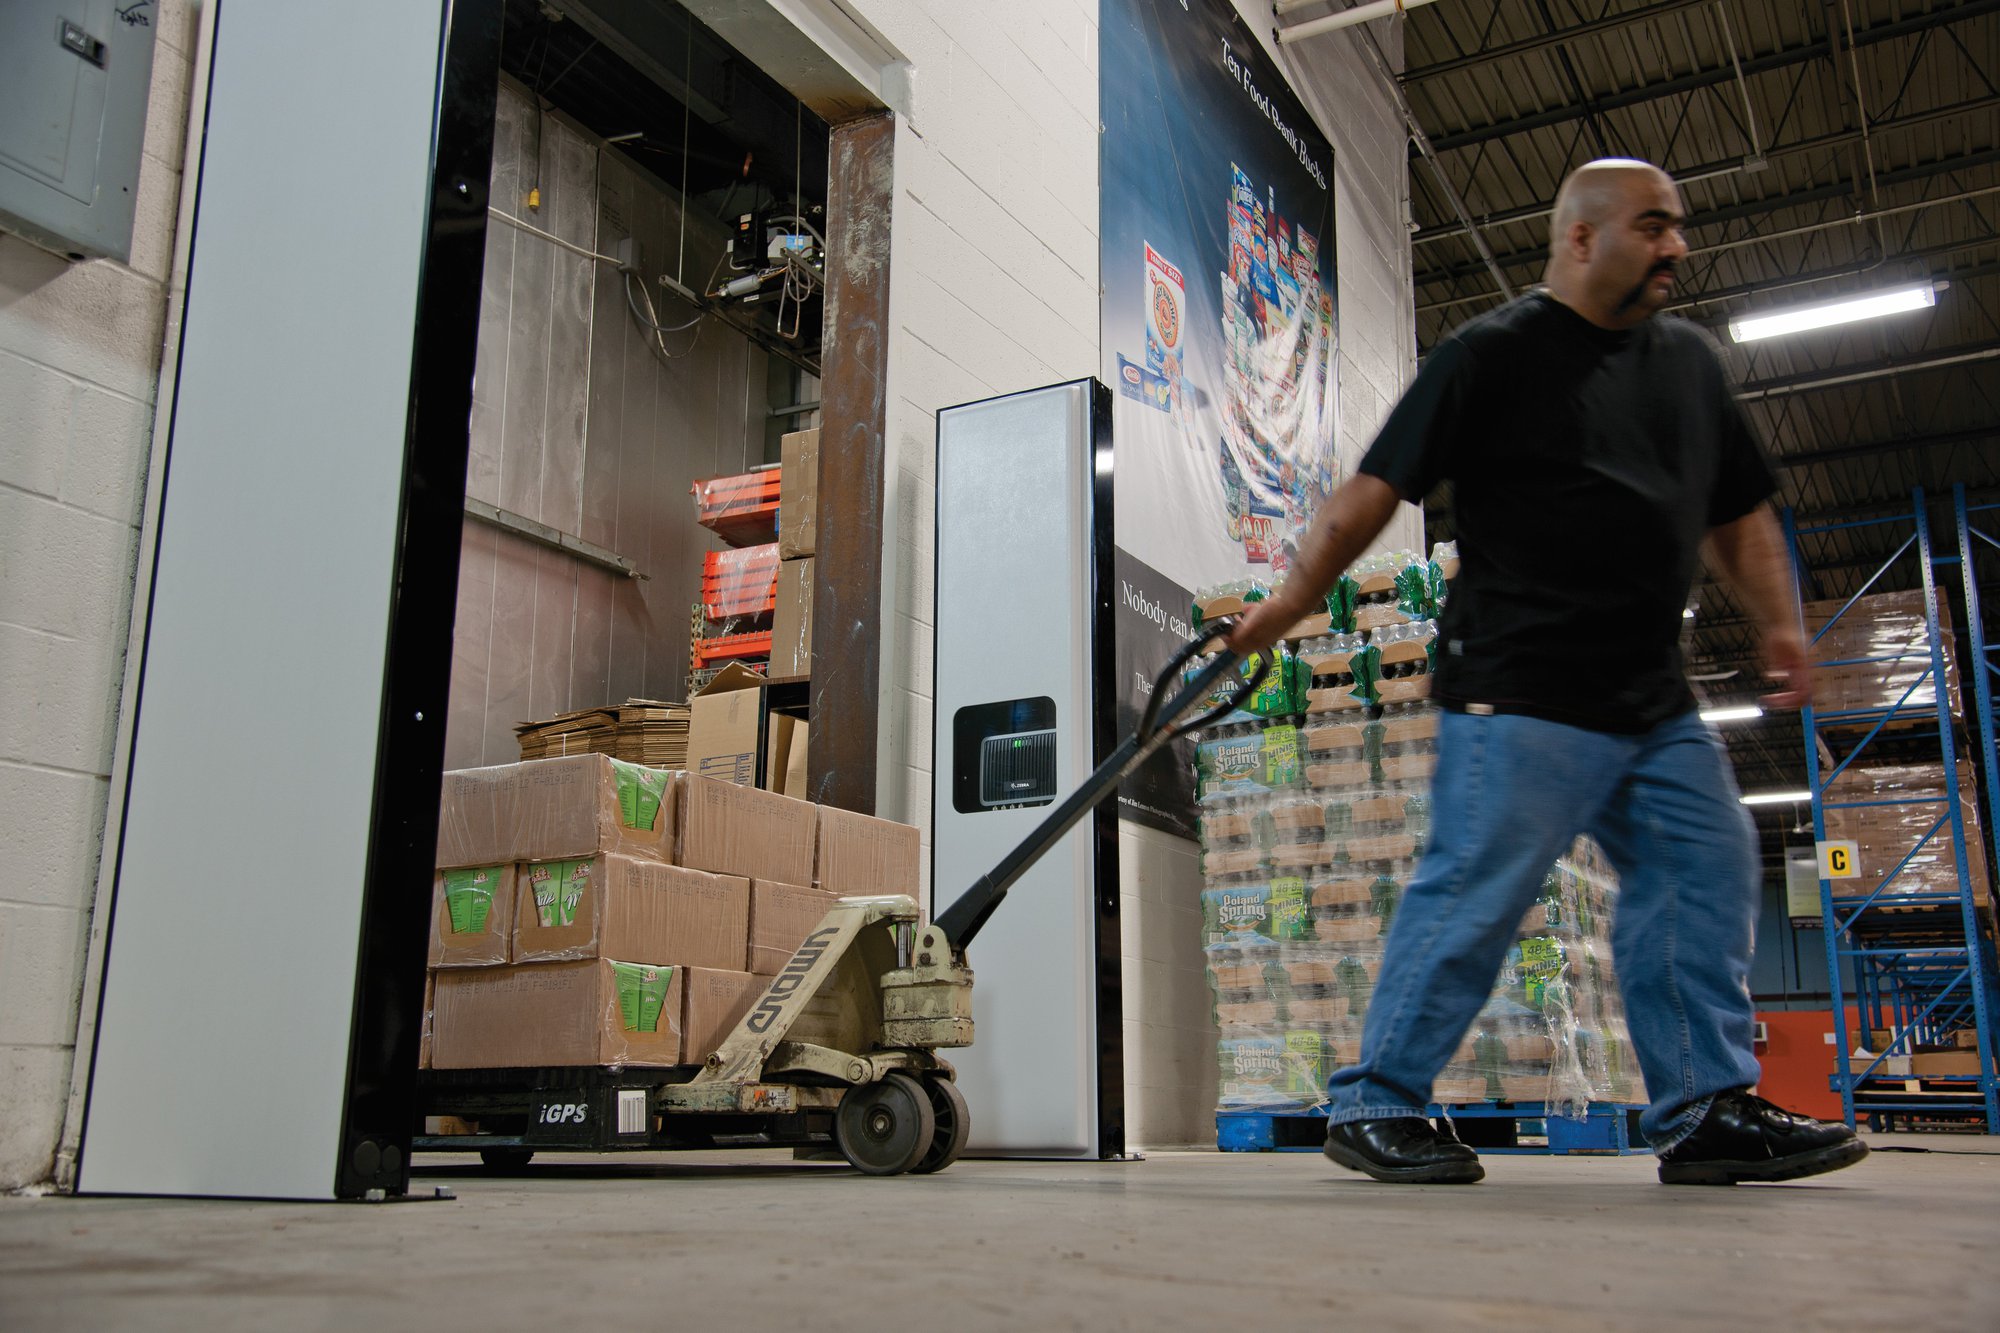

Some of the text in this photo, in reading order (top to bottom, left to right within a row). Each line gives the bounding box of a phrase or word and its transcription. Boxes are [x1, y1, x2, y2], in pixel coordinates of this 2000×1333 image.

[1221, 37, 1327, 190] Ten Food Bank Bucks
[1122, 580, 1188, 639] Nobody can
[1217, 742, 1254, 757] Poland
[1214, 751, 1260, 775] Spring
[1831, 850, 1846, 871] C
[1222, 893, 1260, 908] Poland
[1219, 902, 1267, 924] Spring
[1527, 960, 1558, 977] MINIS
[1237, 1044, 1275, 1057] Poland
[1233, 1056, 1282, 1075] Spring
[539, 1103, 589, 1123] iGPS
